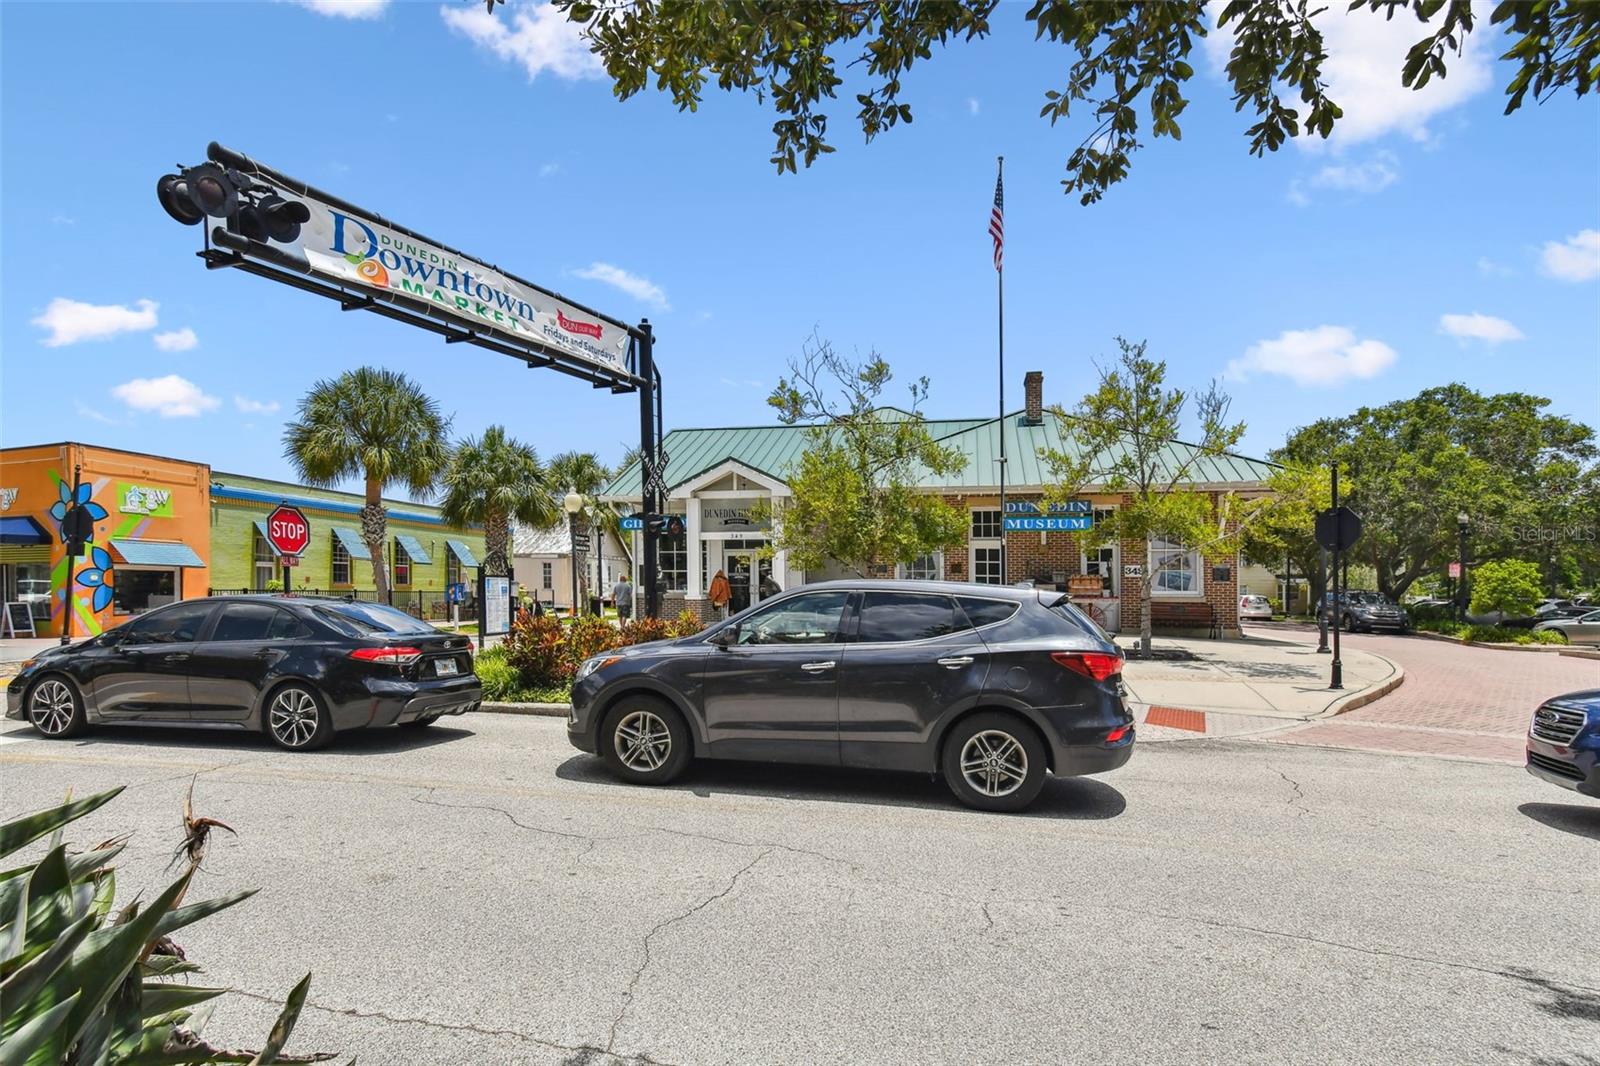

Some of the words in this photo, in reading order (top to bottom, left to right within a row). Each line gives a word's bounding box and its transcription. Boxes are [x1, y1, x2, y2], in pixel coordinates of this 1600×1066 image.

[328, 209, 535, 322] Downtown
[381, 234, 458, 271] DUNEDIN
[402, 278, 518, 330] MARKET
[562, 320, 578, 332] DUN
[543, 325, 569, 343] Fridays
[570, 338, 583, 349] and
[584, 340, 617, 361] Saturdays
[644, 453, 669, 498] CROSSING
[704, 509, 737, 519] DUNEDIN
[1005, 502, 1089, 512] DUNEDIN
[272, 521, 305, 540] STOP
[1007, 519, 1086, 529] MUSEUM
